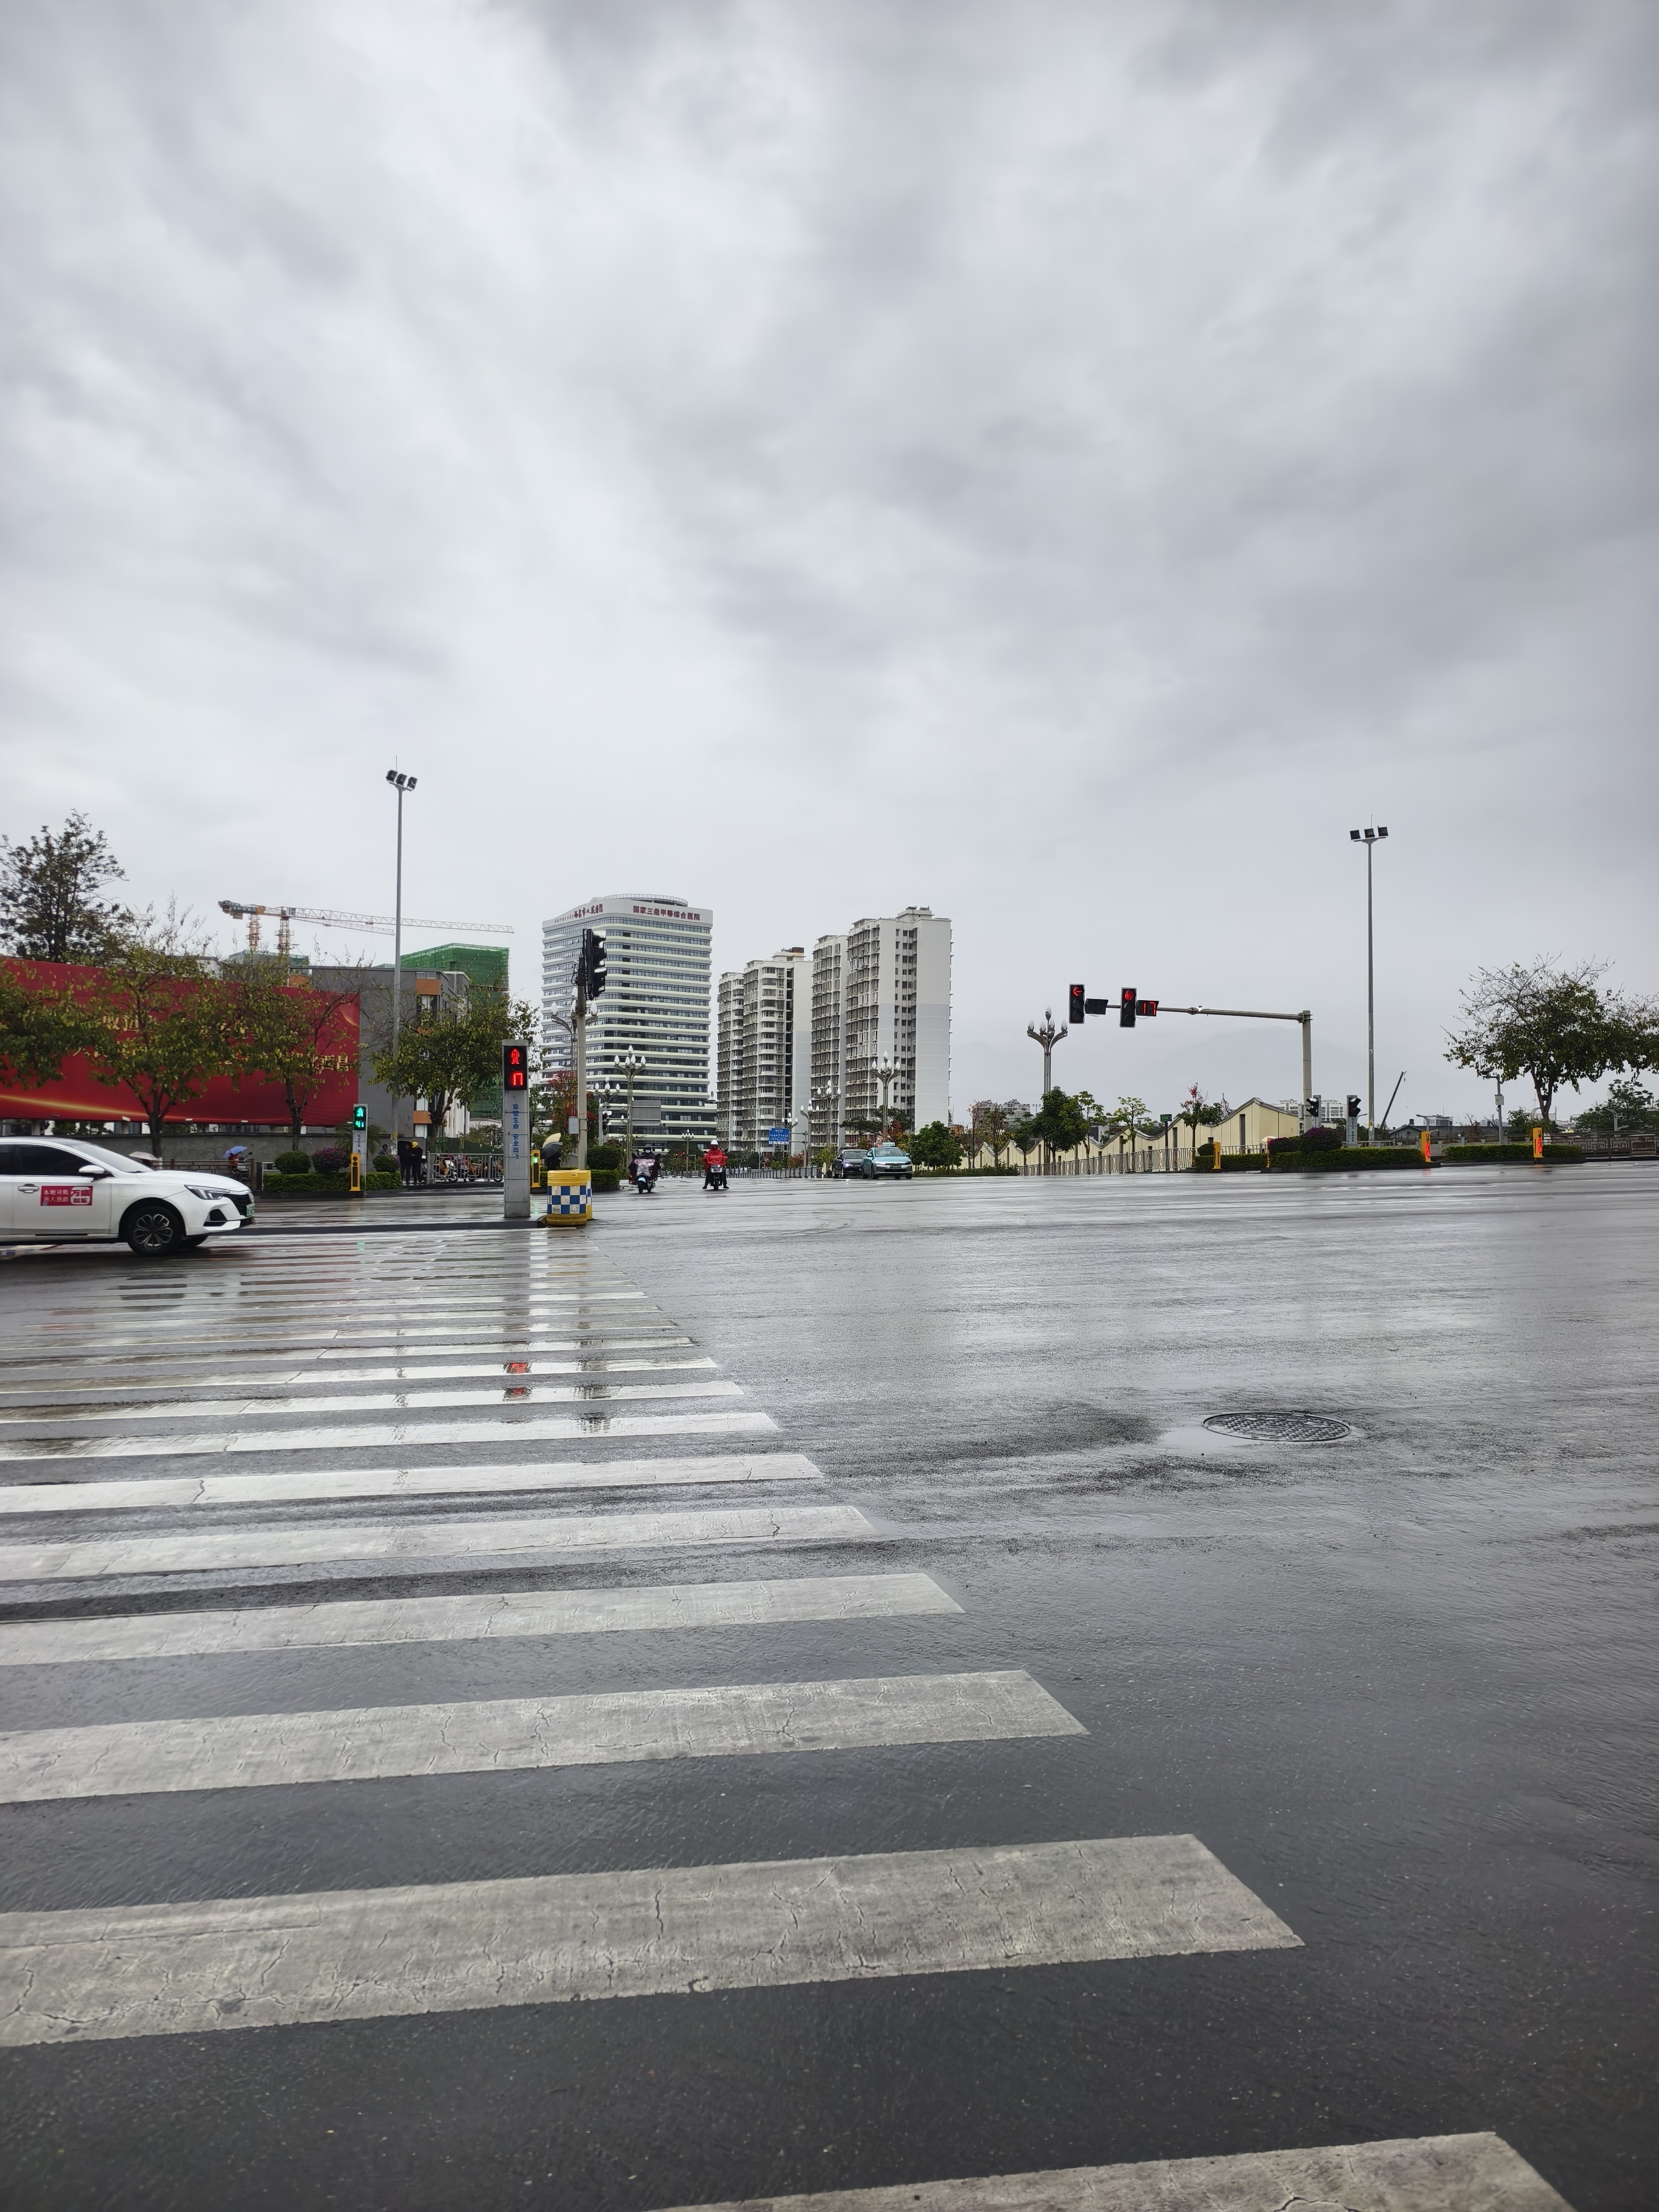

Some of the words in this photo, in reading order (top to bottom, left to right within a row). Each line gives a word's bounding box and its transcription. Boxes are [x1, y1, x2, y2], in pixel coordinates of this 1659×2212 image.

[633, 906, 700, 920] 国家三级甲等综合医院
[1143, 1002, 1156, 1015] 17
